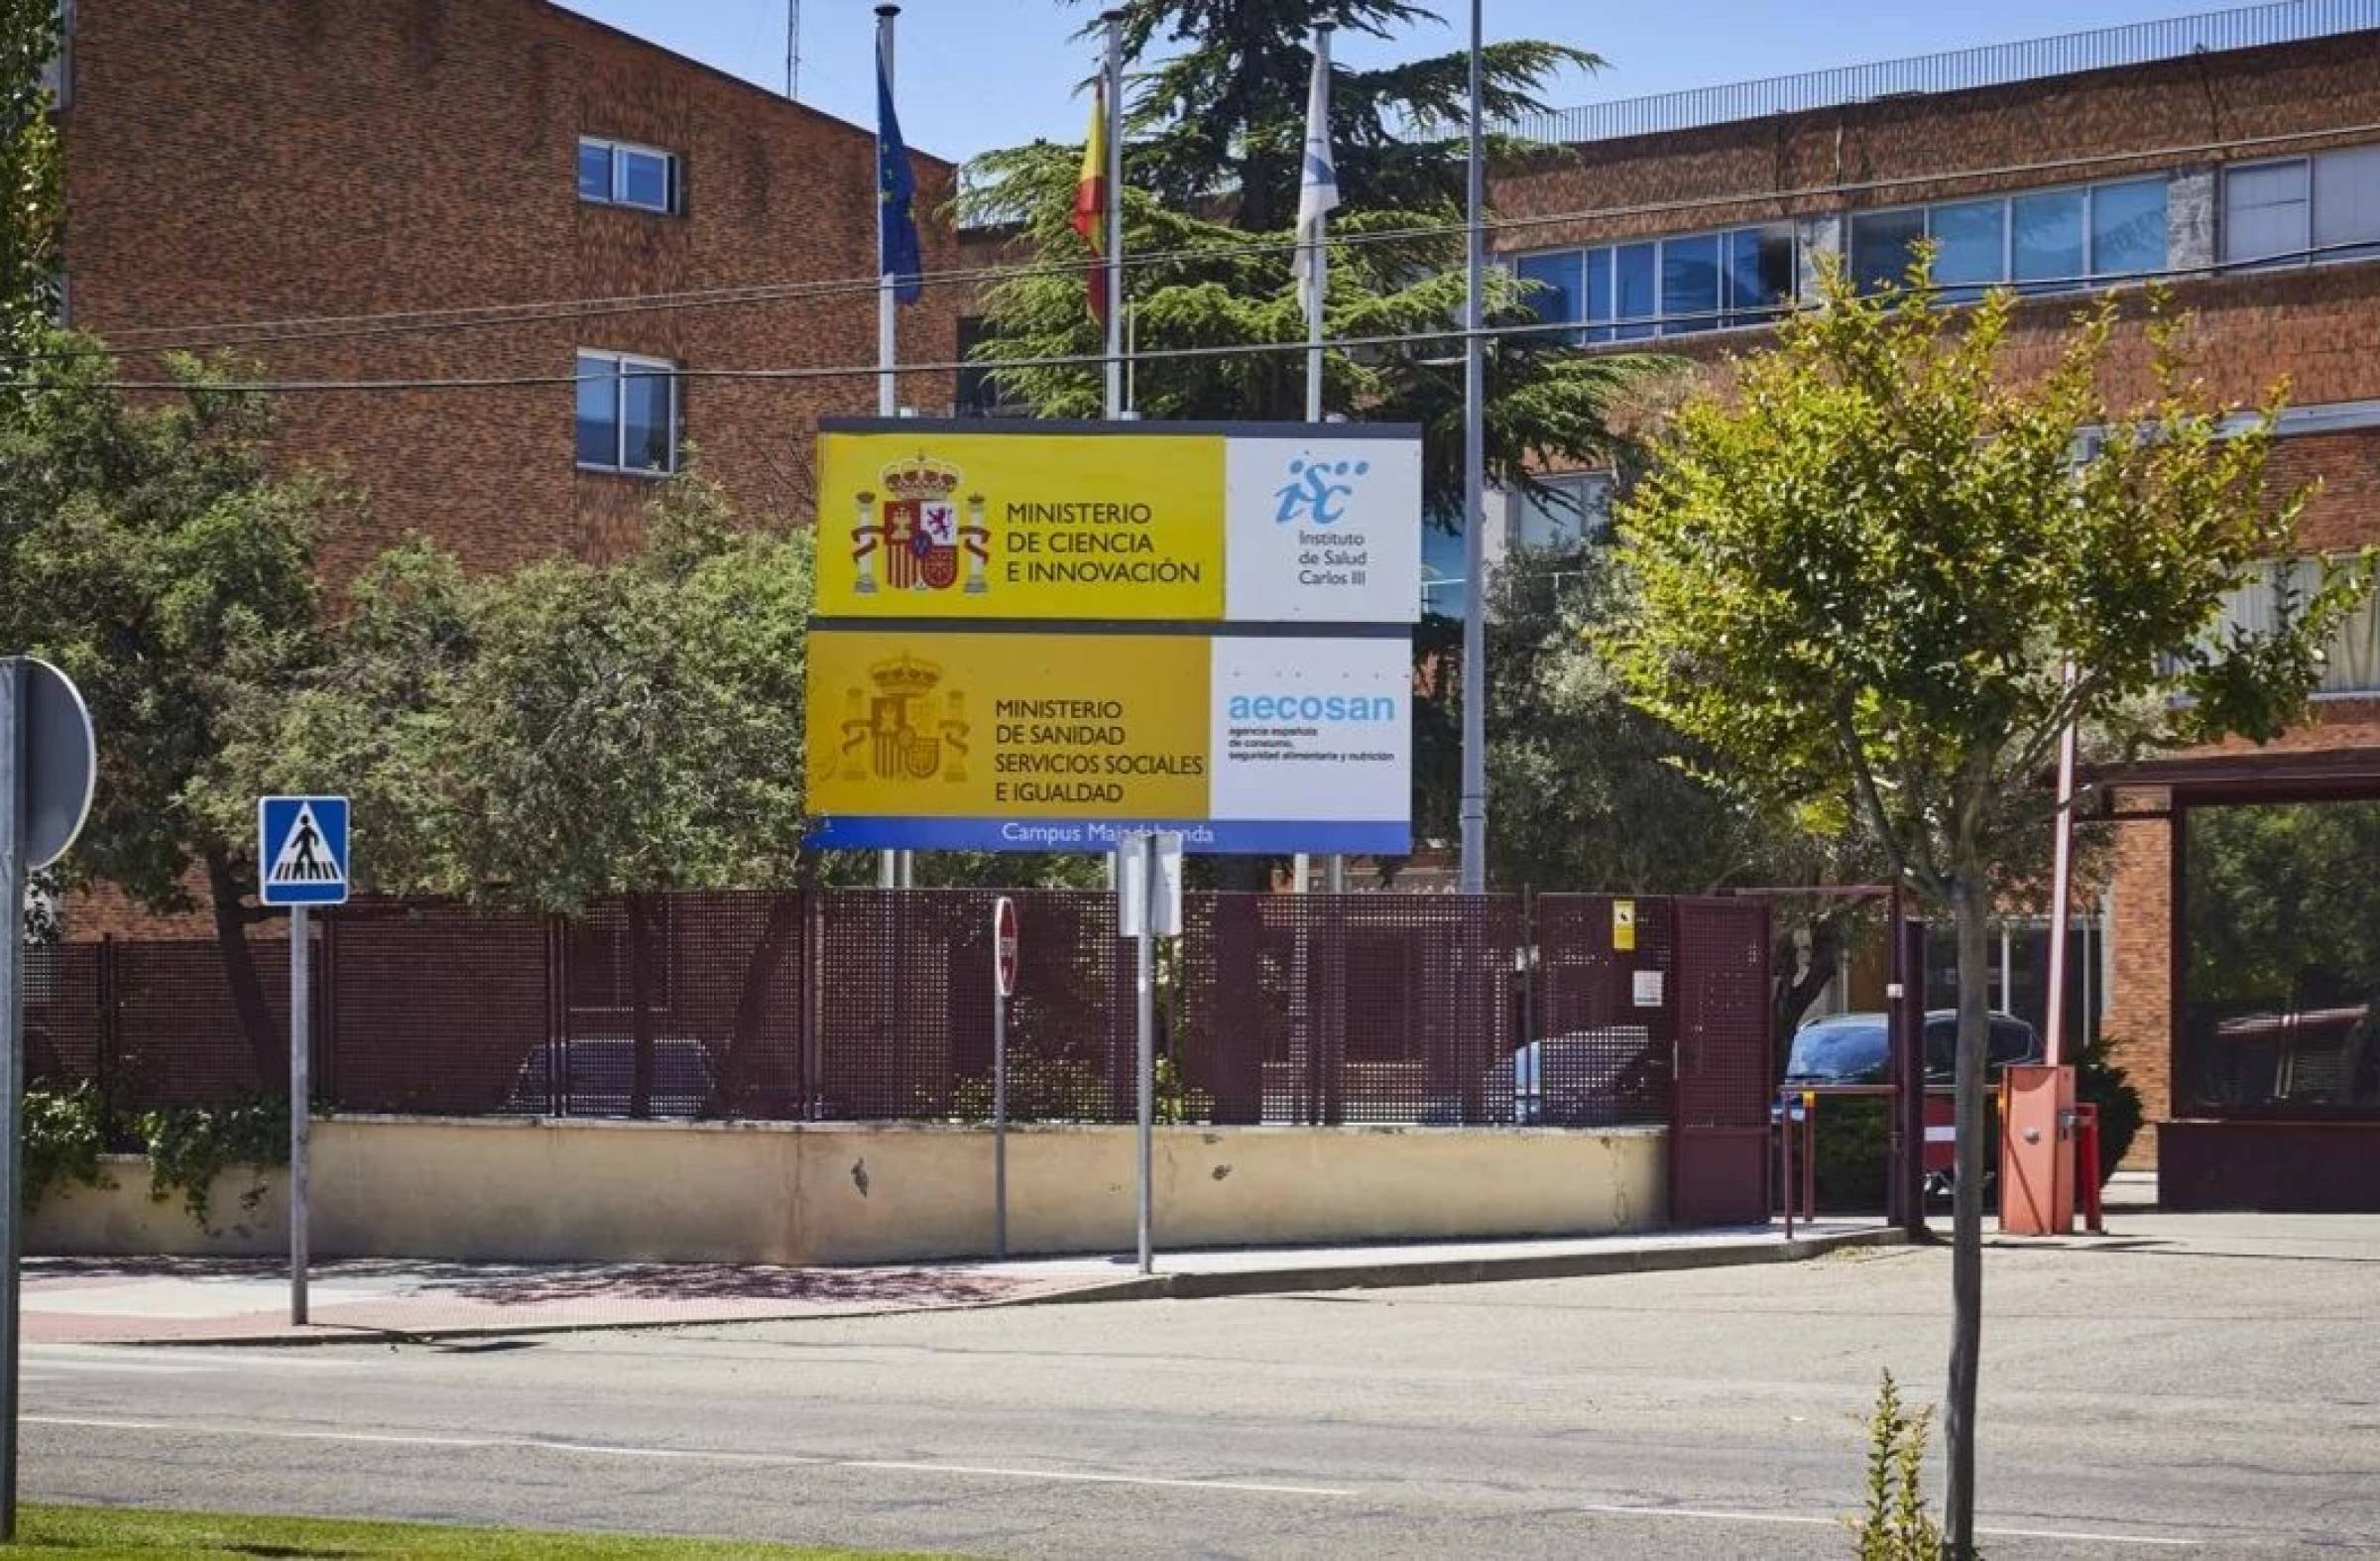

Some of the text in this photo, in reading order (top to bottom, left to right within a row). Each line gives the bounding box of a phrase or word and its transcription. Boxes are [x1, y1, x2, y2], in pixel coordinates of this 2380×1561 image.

[1007, 503, 1152, 524] MINISTERIO
[1007, 532, 1154, 553] DE CIENCIA
[1299, 531, 1366, 545] Instituto
[1298, 550, 1368, 565] de Salud
[1007, 556, 1200, 583] E INNOVACIÓN
[1298, 569, 1367, 585] Carlos III
[996, 700, 1123, 719] MINISTERIO
[1229, 695, 1395, 721] aecosan
[996, 725, 1126, 745] DE SANIDAD
[995, 753, 1204, 775] SERVICIOS SOCIALES
[996, 781, 1124, 802] E IGUALDAD
[1002, 822, 1081, 845] Campus
